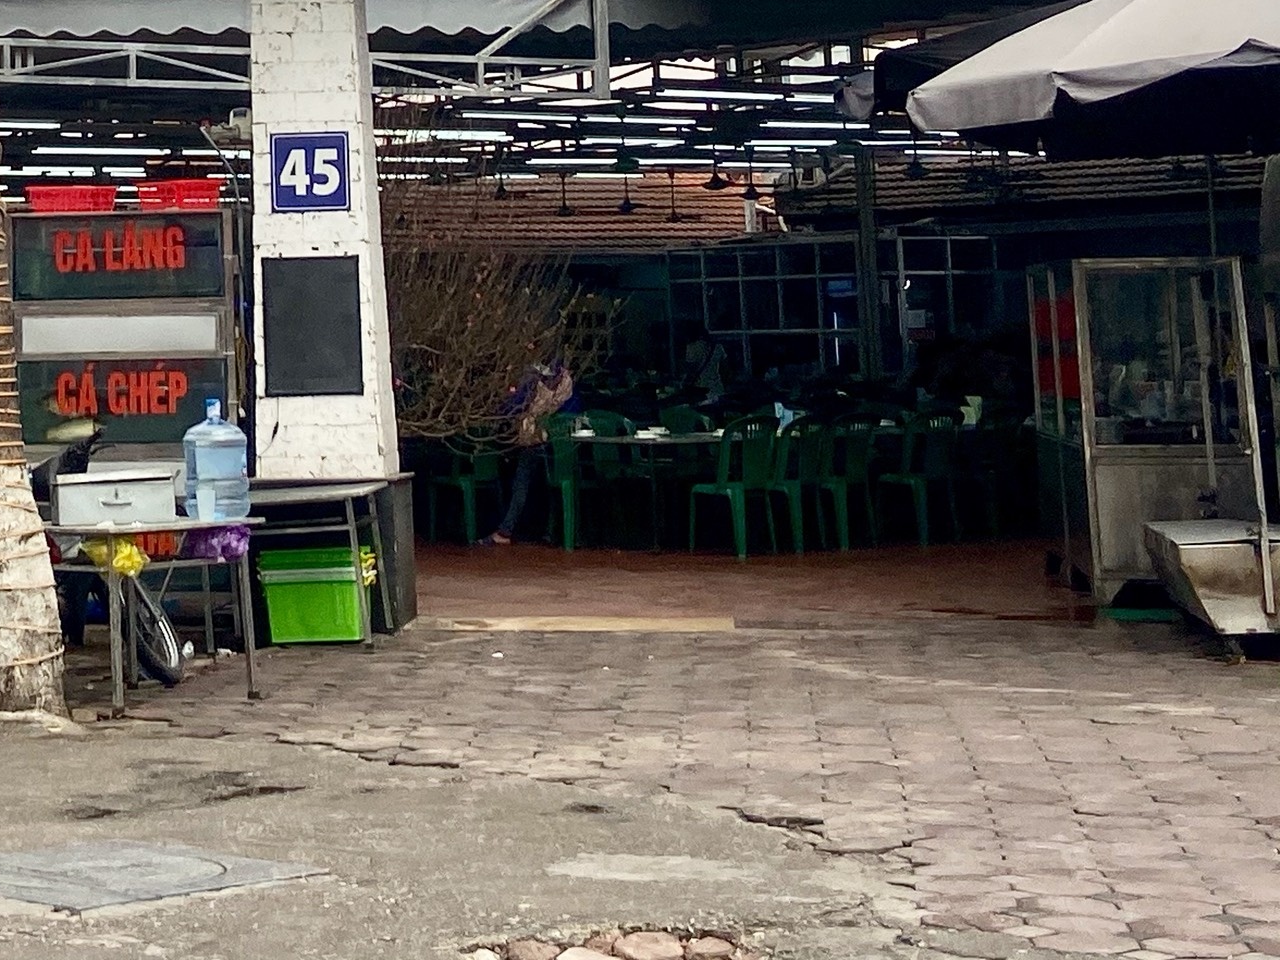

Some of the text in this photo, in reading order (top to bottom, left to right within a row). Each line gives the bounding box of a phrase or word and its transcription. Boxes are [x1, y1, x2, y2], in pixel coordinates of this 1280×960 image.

[280, 148, 340, 196] 45
[56, 362, 188, 417] CÁ CHÉP
